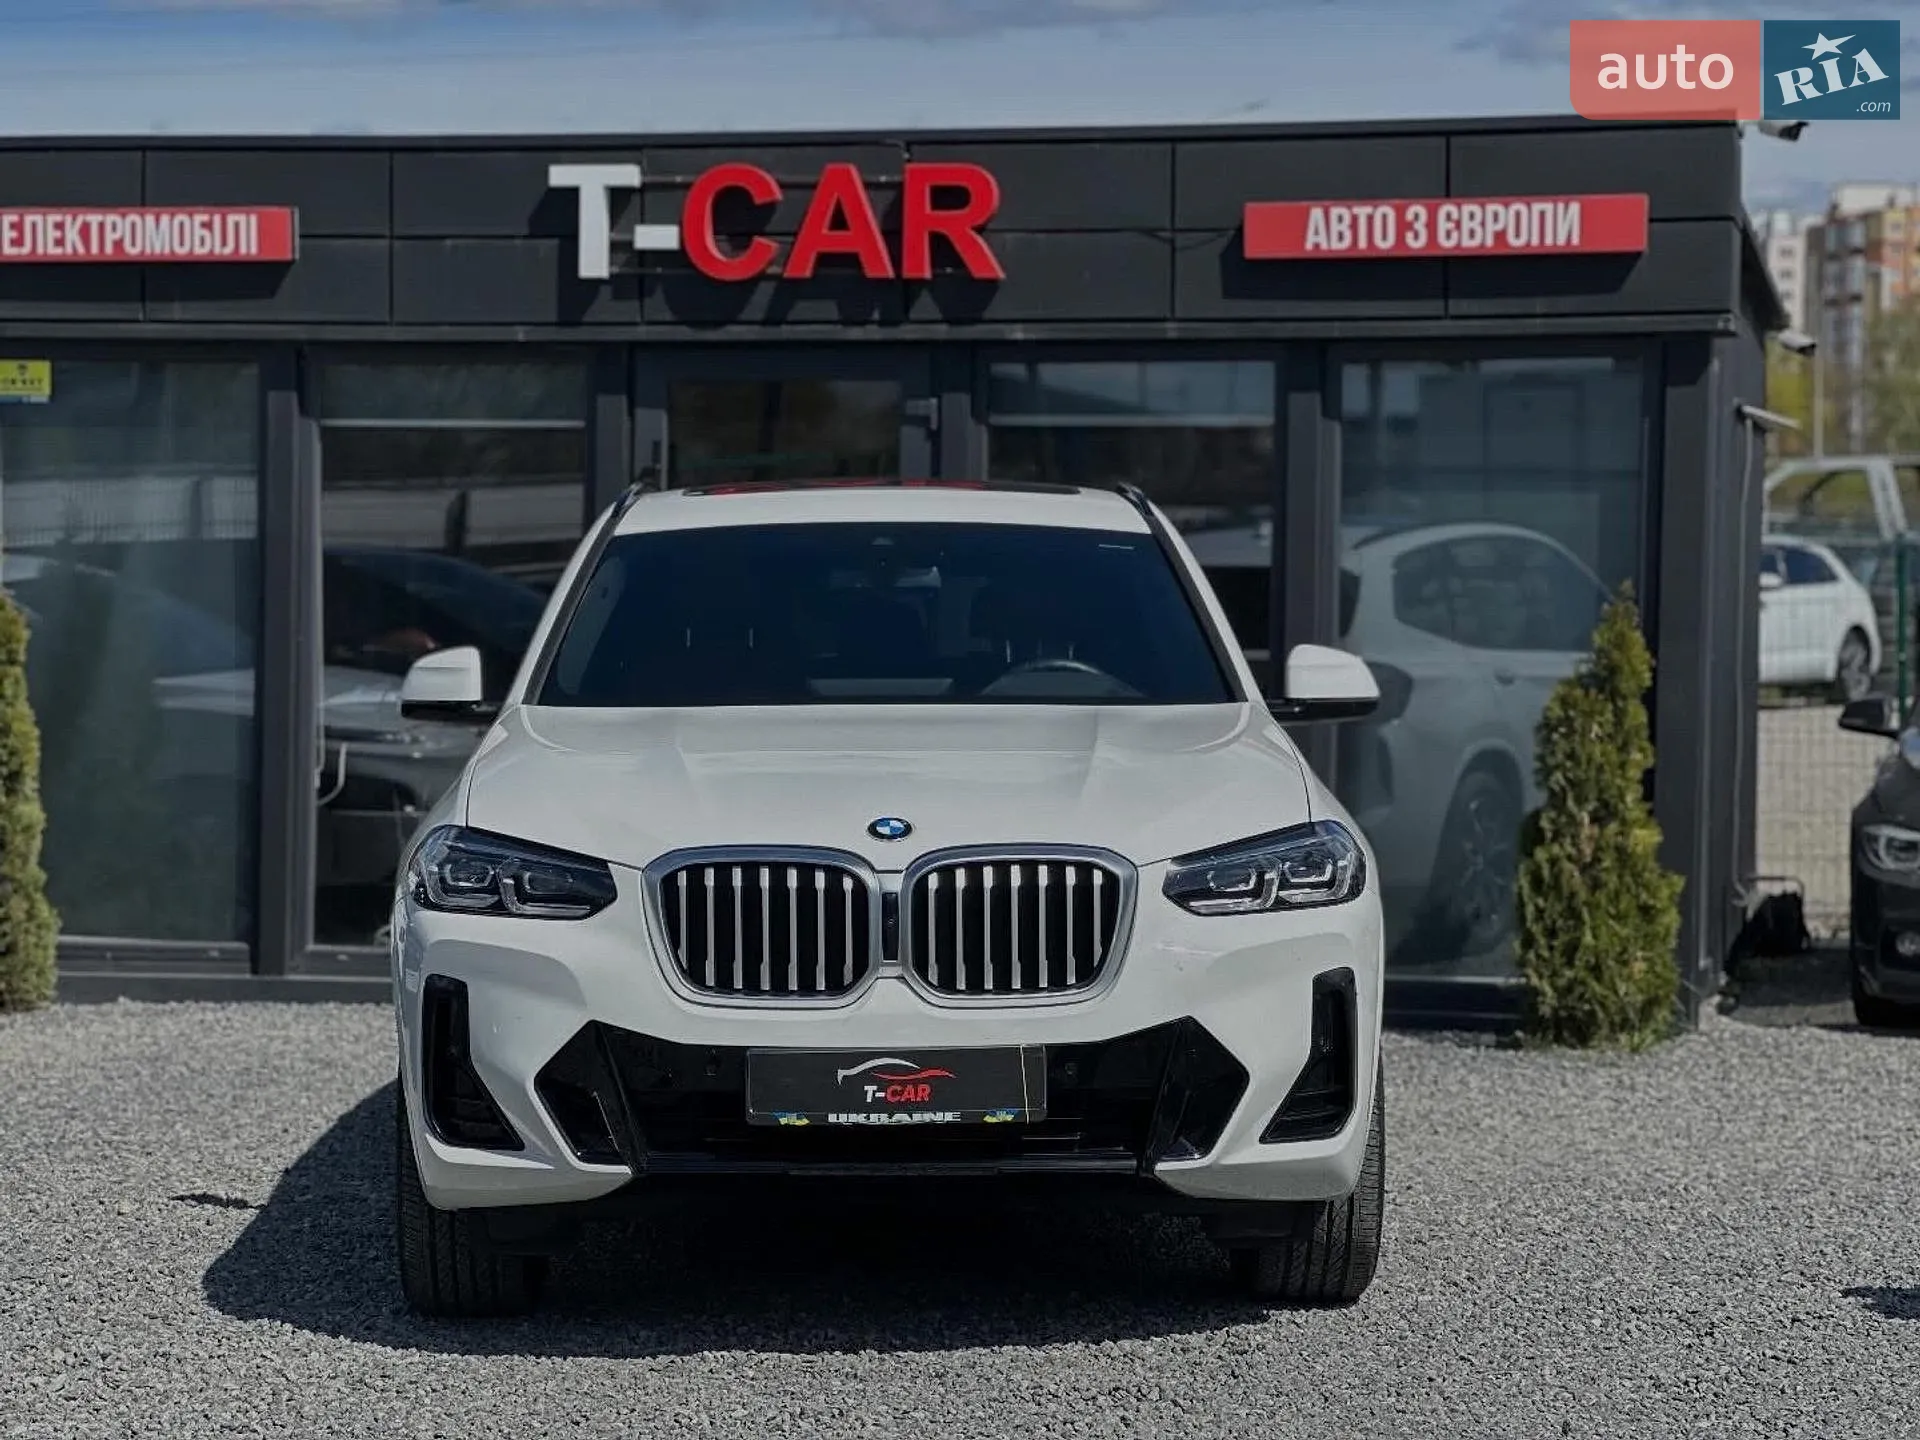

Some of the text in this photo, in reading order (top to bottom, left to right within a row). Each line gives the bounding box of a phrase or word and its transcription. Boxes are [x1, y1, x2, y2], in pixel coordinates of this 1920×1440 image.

[1, 213, 259, 256] ЕЛЕКТРОМОБІЛІ
[548, 162, 1006, 281] T-CAR
[1305, 201, 1581, 251] АВТО З ЄВРОПИ
[864, 1084, 932, 1102] T-CAR
[828, 1112, 962, 1125] UKRAINE
